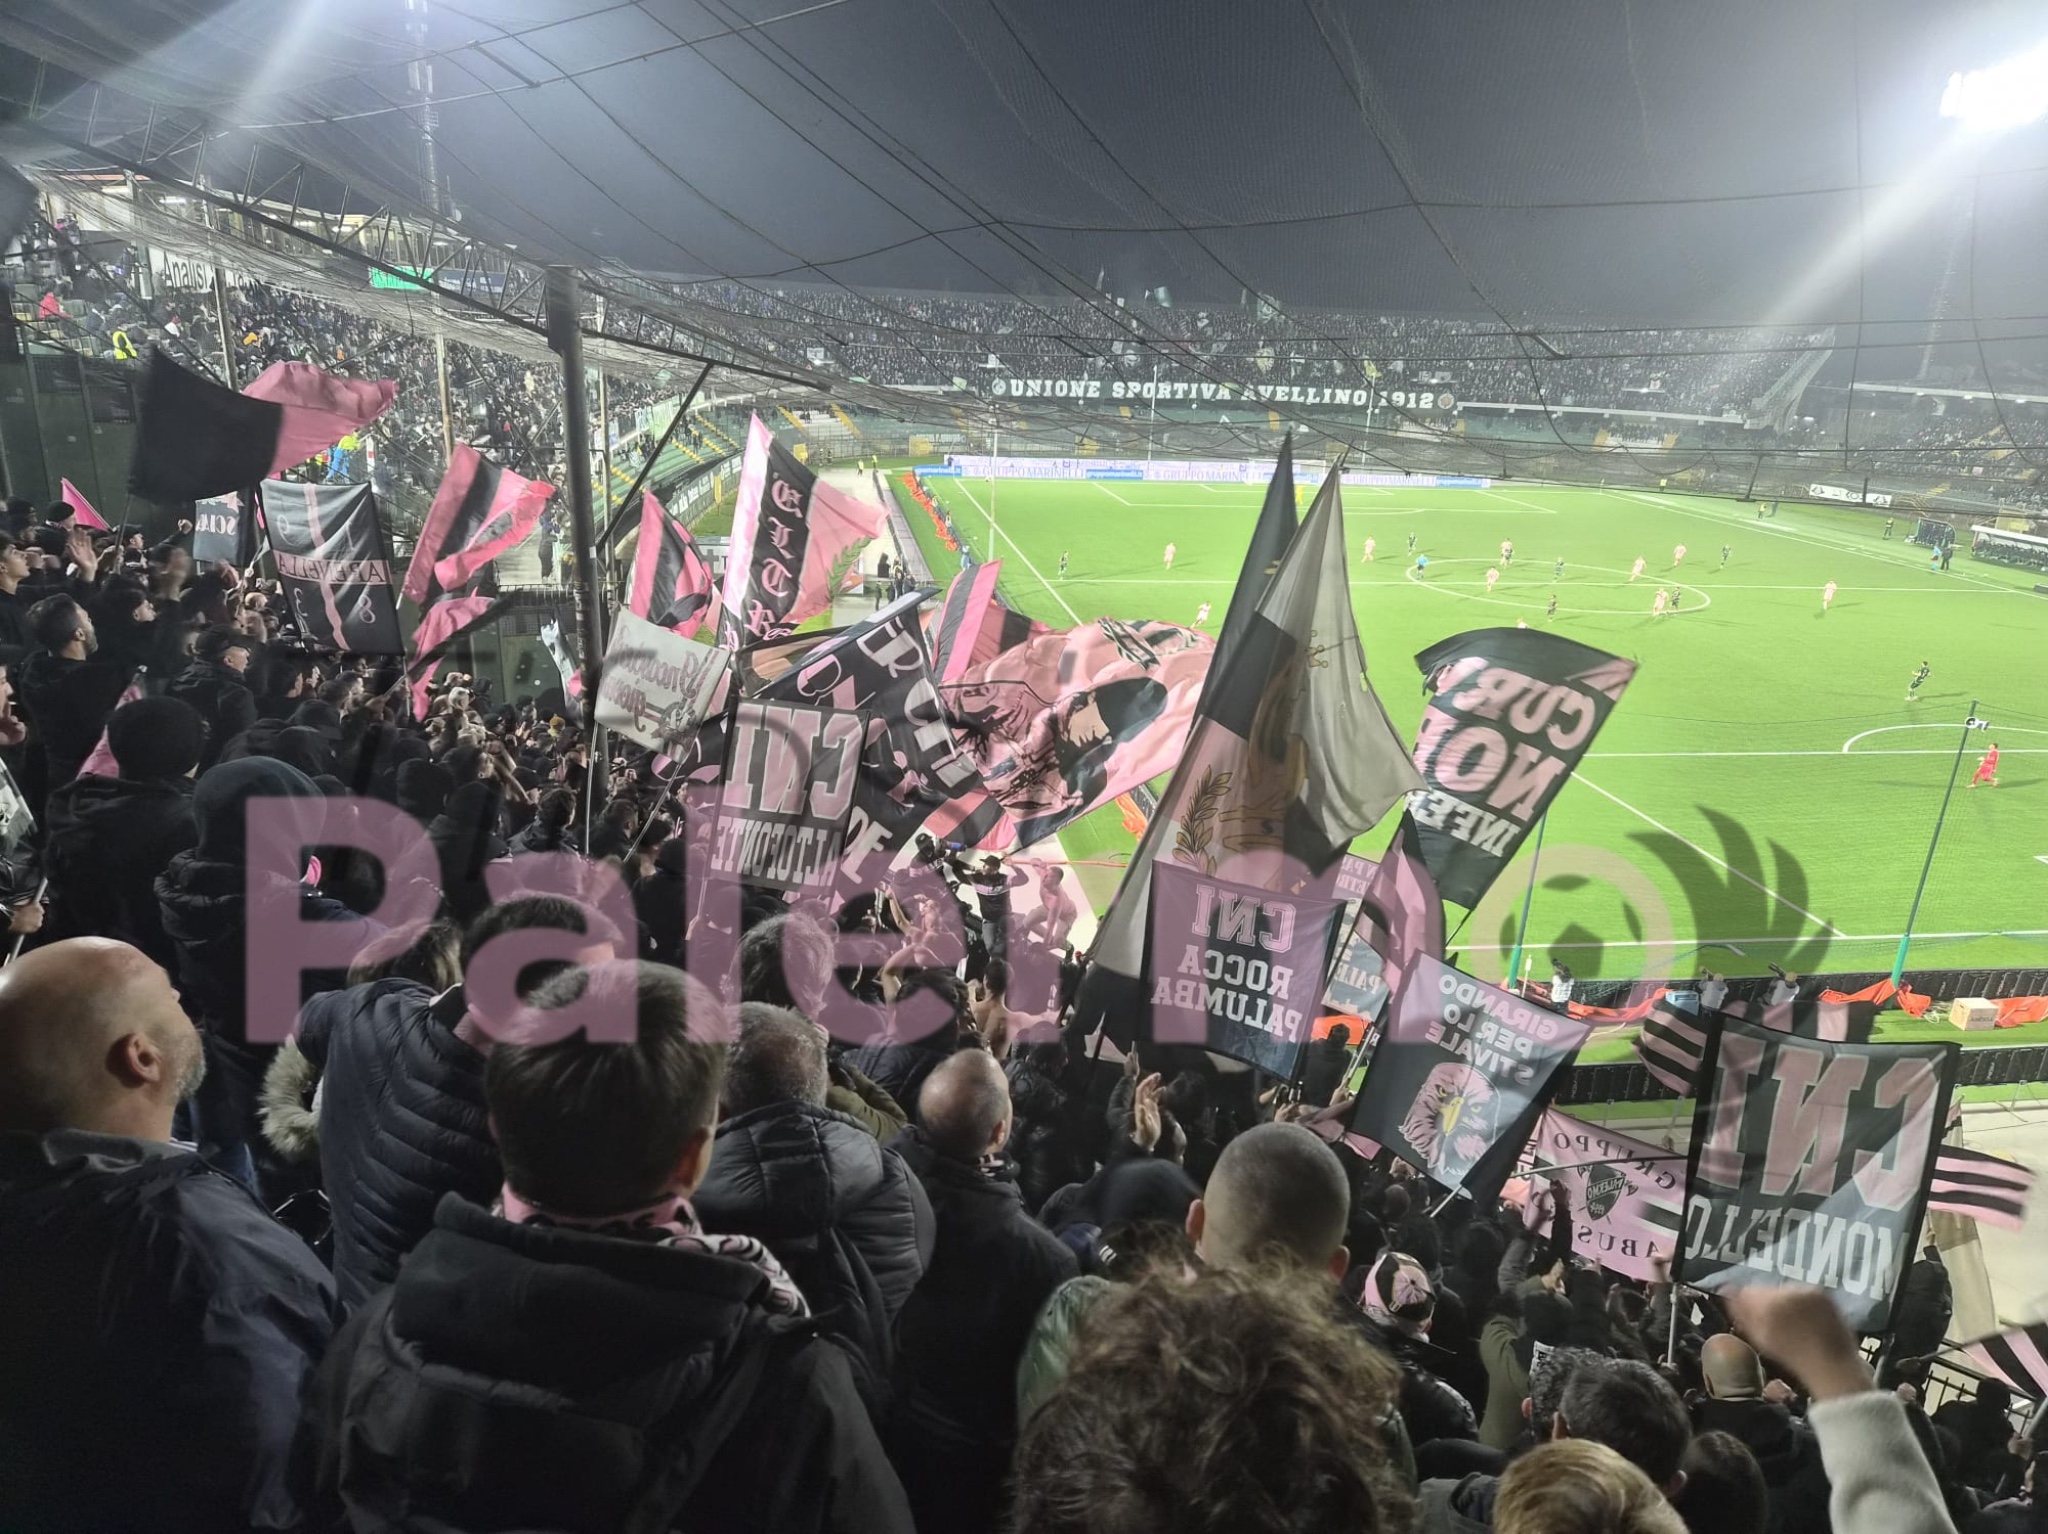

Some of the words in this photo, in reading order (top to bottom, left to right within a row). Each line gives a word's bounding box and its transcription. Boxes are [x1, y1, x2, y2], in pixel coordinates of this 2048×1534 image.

[1010, 379, 1100, 398] UNIONE
[1112, 380, 1232, 401] SPORTIVA
[1241, 385, 1367, 407] AVELLINO
[1379, 390, 1435, 409] 1912
[982, 466, 1025, 479] GRUPPO
[1027, 466, 1085, 480] MARINELLI
[1163, 468, 1205, 481] GRUPPO
